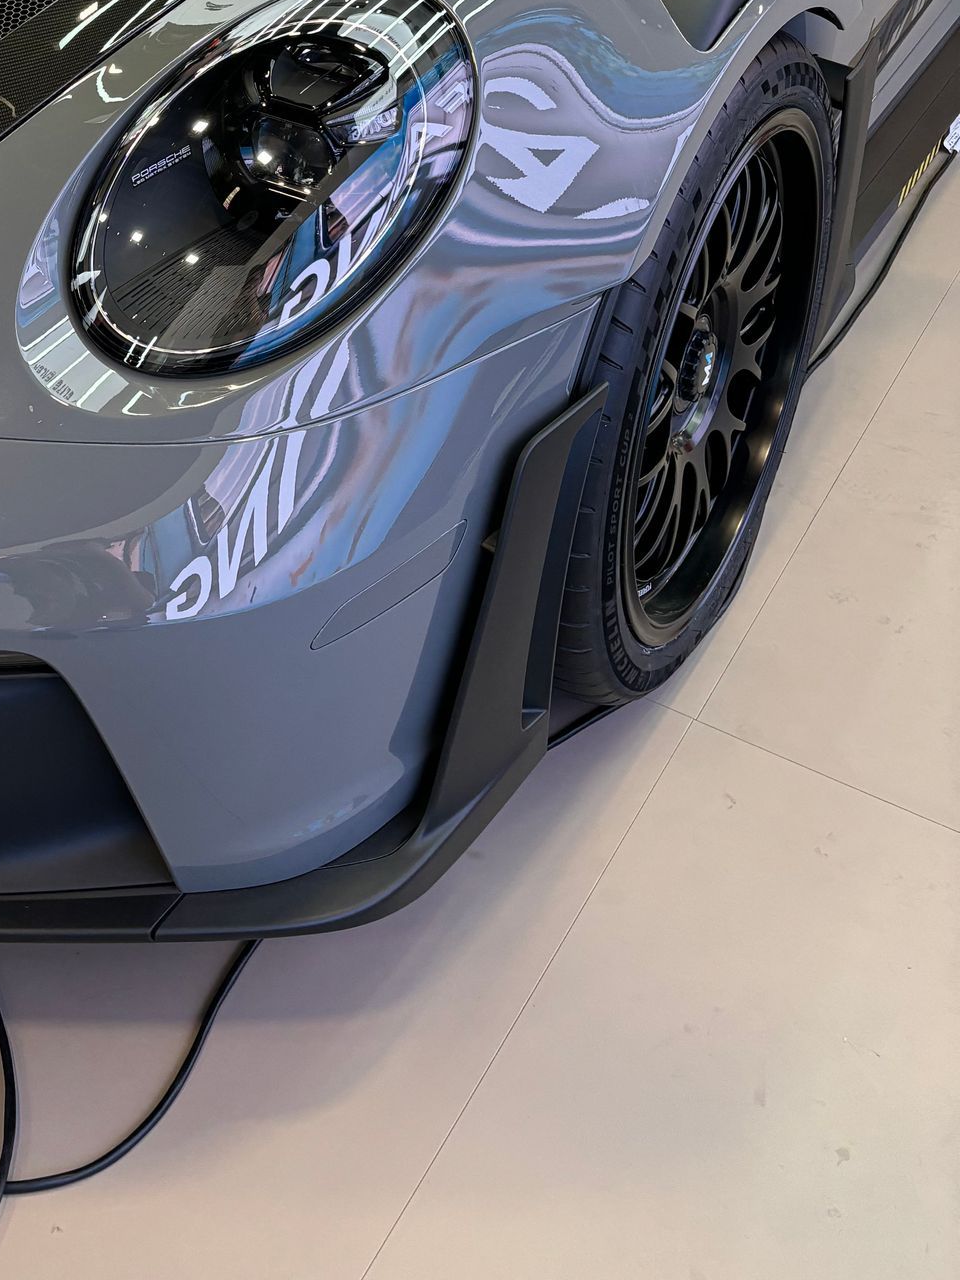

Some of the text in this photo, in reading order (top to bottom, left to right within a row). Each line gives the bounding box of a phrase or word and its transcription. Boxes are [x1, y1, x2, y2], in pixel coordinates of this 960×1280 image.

[131, 144, 191, 183] PORSCHE
[133, 151, 192, 187] LED MATRIX SYSTEM
[619, 428, 633, 467] CUP
[610, 477, 624, 536] SPORT
[606, 543, 616, 585] PILOT
[604, 598, 640, 685] MICHELIN
